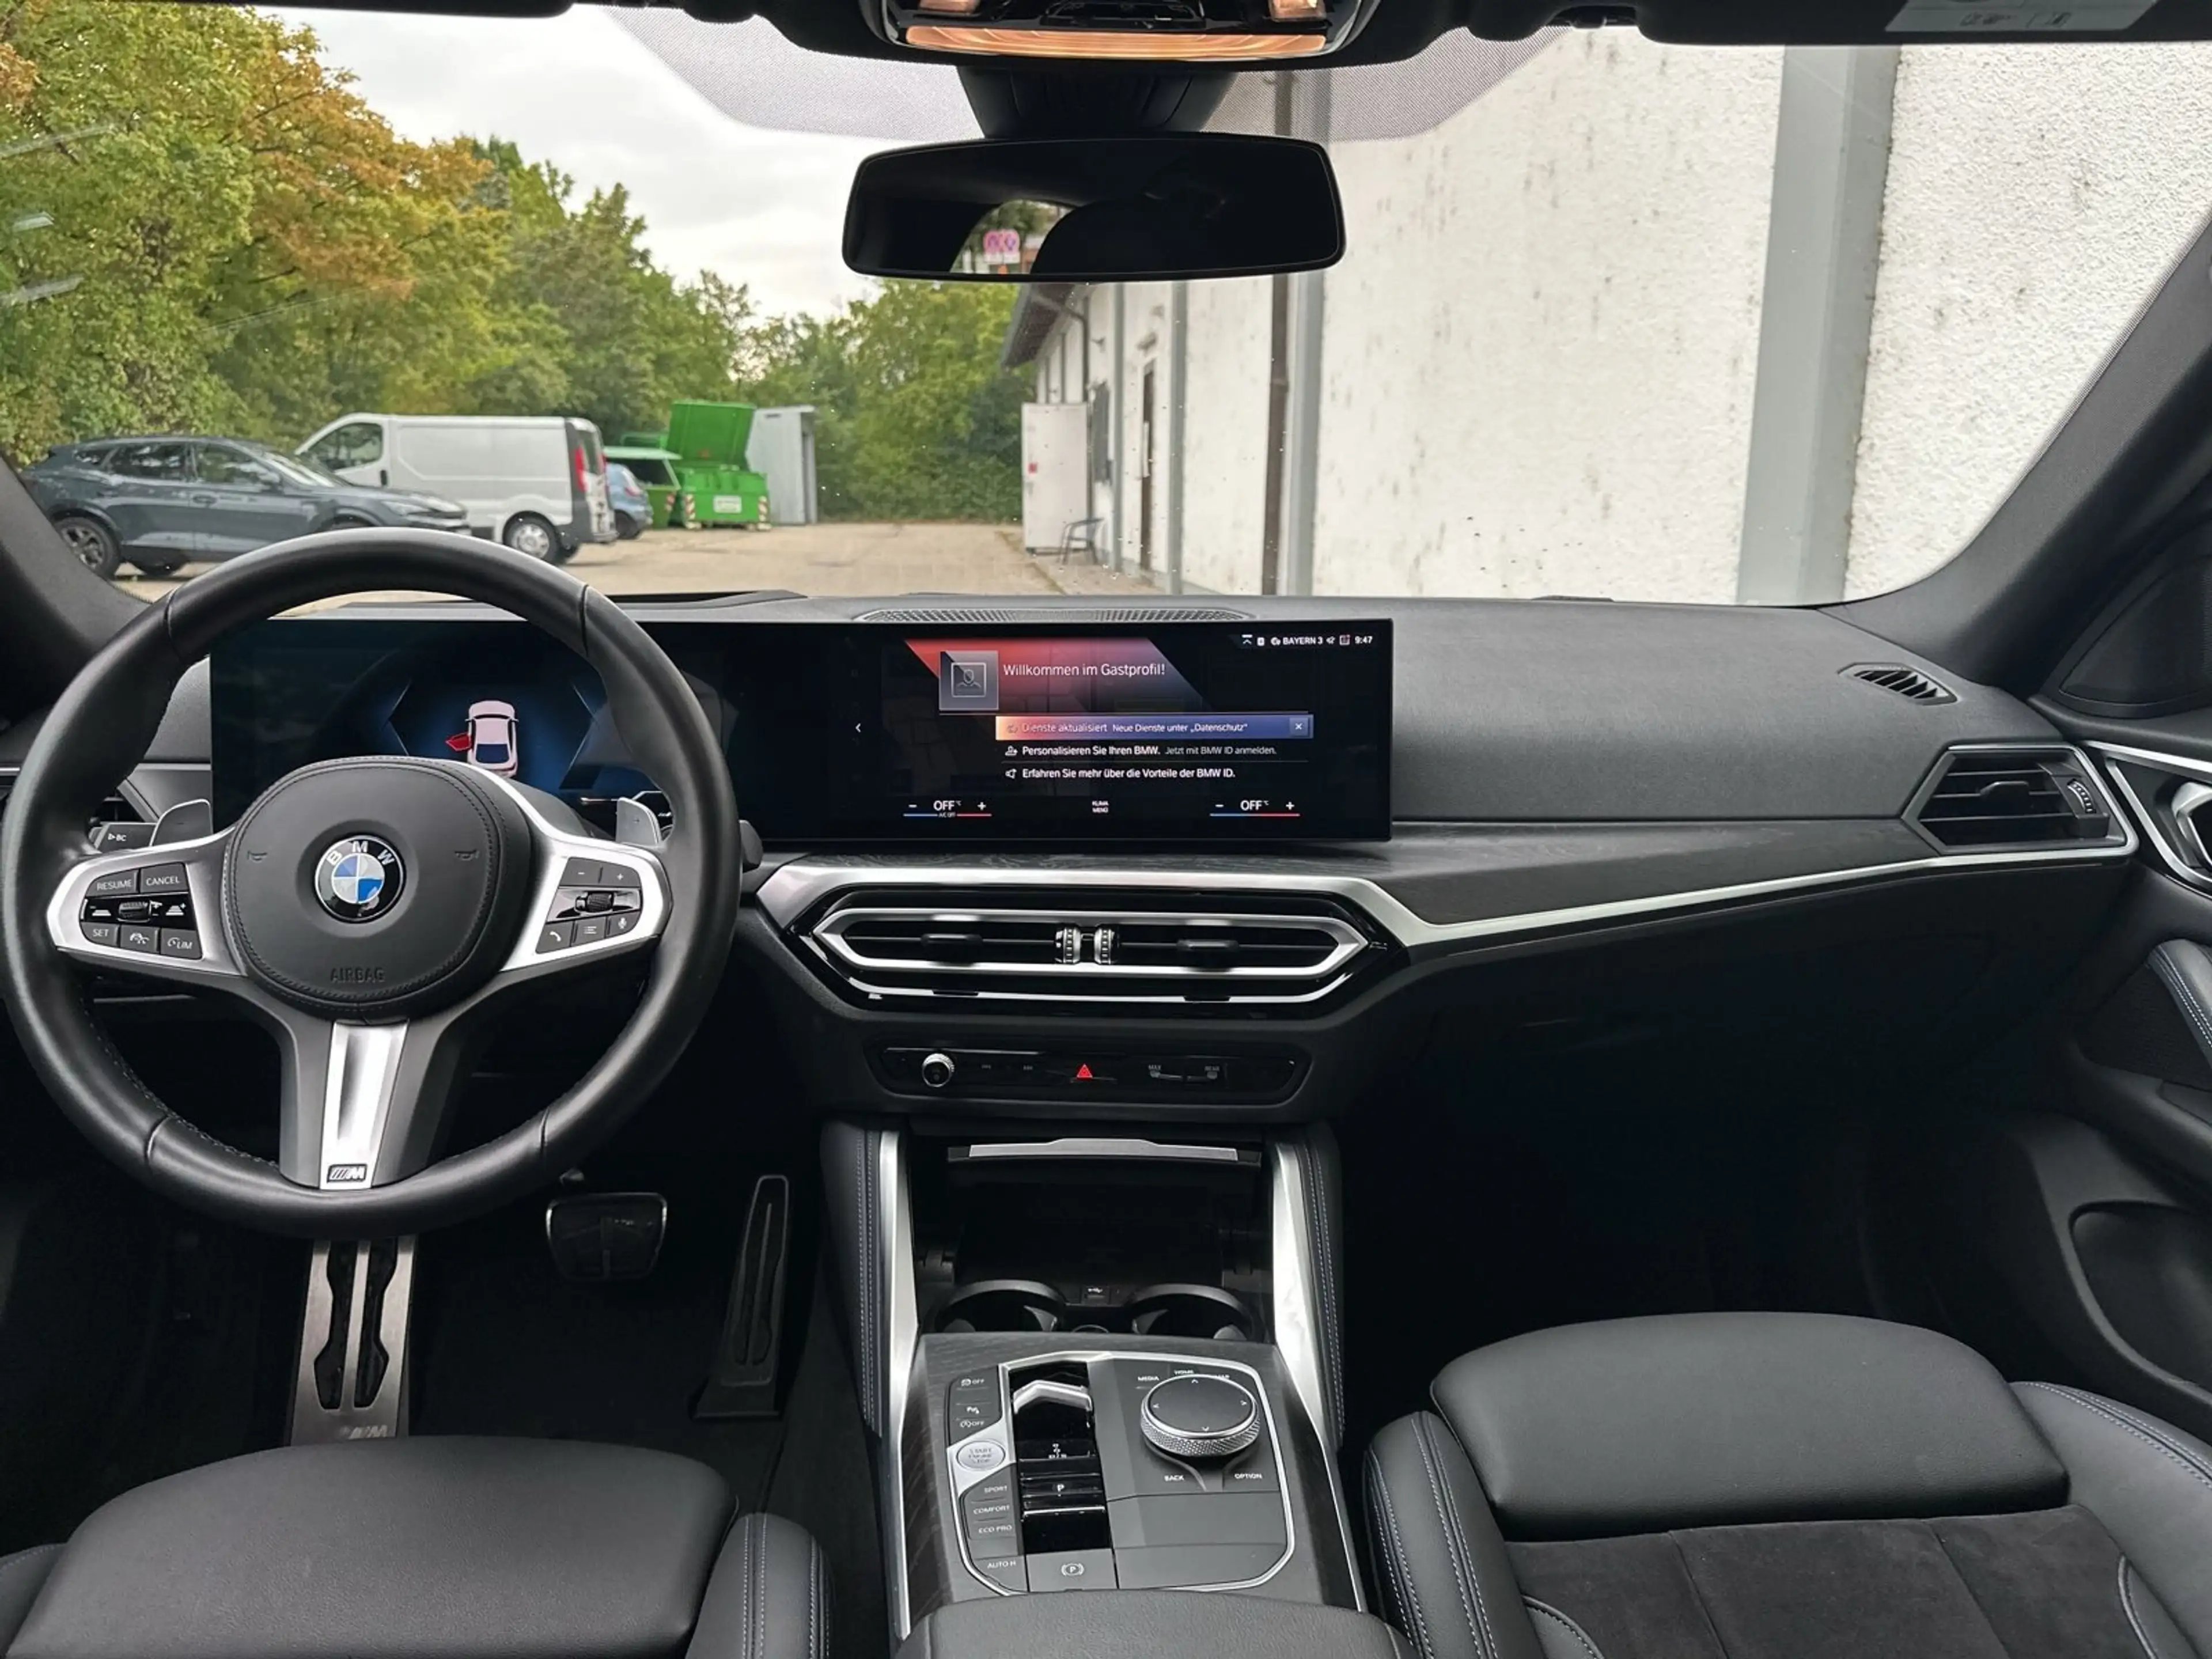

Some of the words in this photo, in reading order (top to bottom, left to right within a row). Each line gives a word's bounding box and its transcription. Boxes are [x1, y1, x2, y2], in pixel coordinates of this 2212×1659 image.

[1282, 636, 1316, 645] BAYERN
[1317, 636, 1323, 645] 3
[1354, 635, 1373, 644] 9:47
[1003, 664, 1080, 676] Willkommen
[1082, 664, 1097, 676] im
[1100, 664, 1165, 677] Gastprofil!
[1021, 722, 1057, 733] Dienste
[1058, 722, 1108, 733] aktualisiert
[1112, 723, 1134, 732] Neue
[1135, 723, 1166, 732] Dienste
[1022, 745, 1091, 756] Personalisieren
[1092, 746, 1107, 755] Sie
[1108, 746, 1132, 755] Ihren
[1134, 746, 1161, 755] BMW.
[1164, 747, 1184, 755] Jetzt
[1185, 747, 1199, 755] mit
[1200, 747, 1223, 755] BMW
[1224, 747, 1233, 755] ID
[1234, 747, 1277, 755] anmelden.
[1022, 768, 1061, 778] Erfahren
[1062, 768, 1077, 778] Sie
[1078, 768, 1102, 778] mehr
[1103, 768, 1125, 778] über
[1126, 768, 1141, 778] die
[1142, 768, 1178, 778] Vorteile
[1179, 768, 1195, 778] der
[1196, 768, 1222, 778] BMW
[1223, 768, 1236, 778] ID.
[933, 800, 955, 811] OFF
[1240, 800, 1262, 811] OFF
[327, 840, 395, 866] BMW
[97, 879, 132, 891] RESUME
[146, 876, 180, 887] CANCEL
[93, 929, 108, 937] SET
[177, 941, 193, 949] LIM
[330, 967, 386, 983] AIRBAG
[984, 1485, 1007, 1493] SPORT
[1057, 1483, 1065, 1492] P
[973, 1505, 1010, 1514] COMFORT
[987, 1560, 1008, 1569] AUTO
